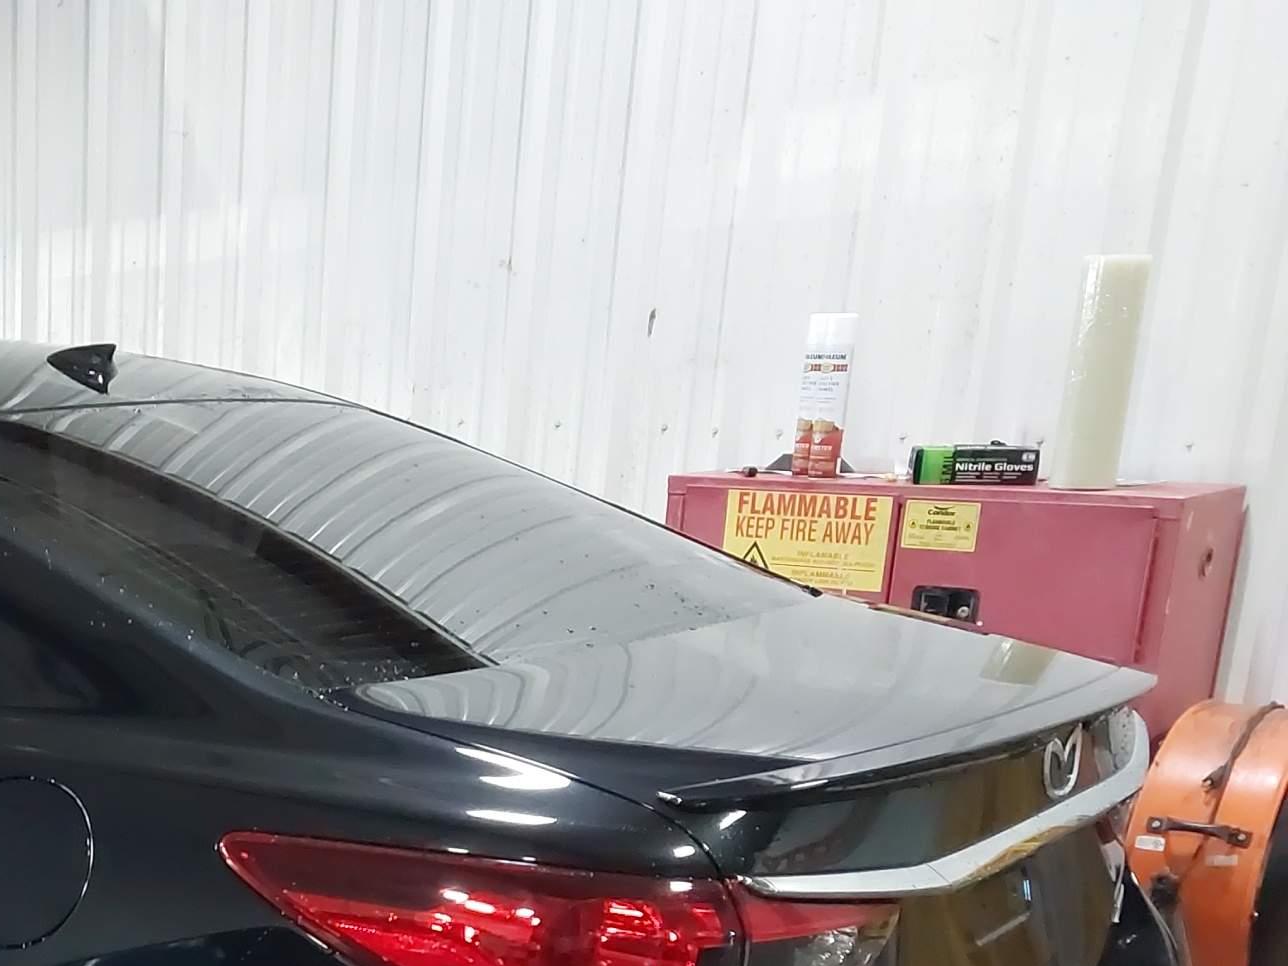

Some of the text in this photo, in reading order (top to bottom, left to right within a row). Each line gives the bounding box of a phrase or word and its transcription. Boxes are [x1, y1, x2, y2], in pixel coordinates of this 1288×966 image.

[955, 462, 1034, 472] Nitrile Gloves
[737, 491, 878, 521] FLAMMABLE
[735, 515, 875, 546] KEEP FIRE AWAY
